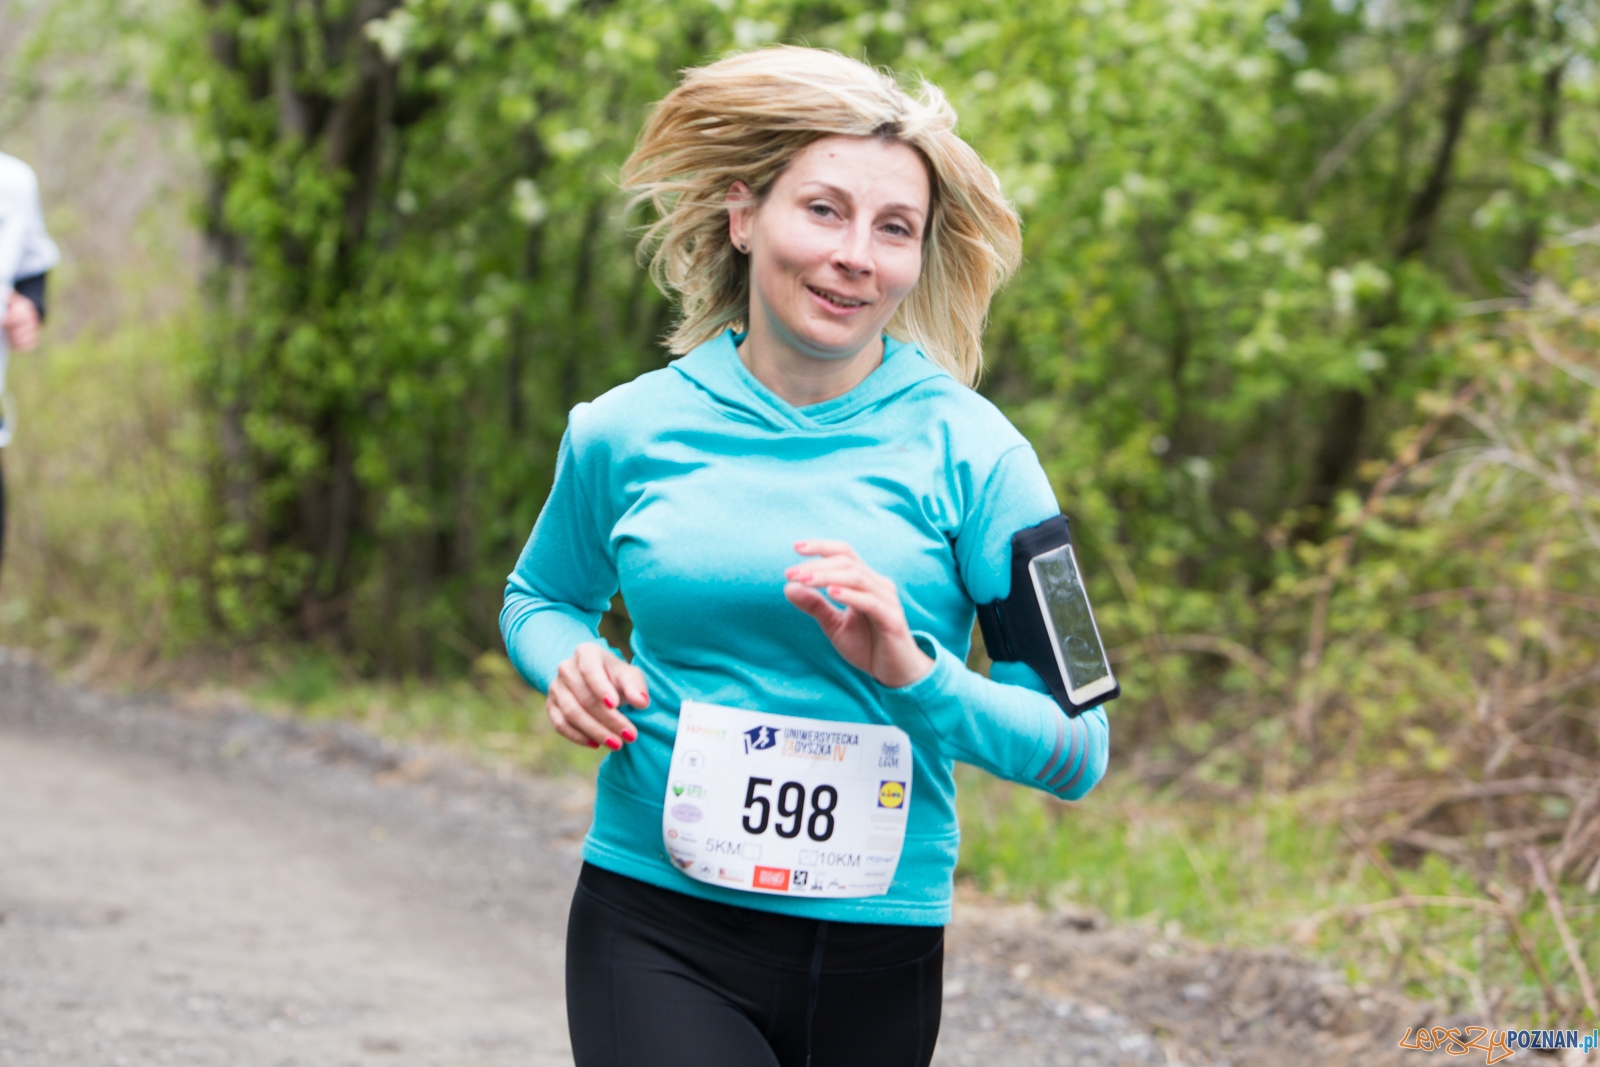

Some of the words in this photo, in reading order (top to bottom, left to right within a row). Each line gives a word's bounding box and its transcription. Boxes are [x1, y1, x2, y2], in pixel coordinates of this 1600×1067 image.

[783, 728, 859, 745] UNIWERSYTECKA
[782, 738, 831, 756] ZADYSZKA
[833, 745, 847, 762] IV
[742, 776, 838, 842] 598
[704, 838, 741, 856] 5KM
[819, 852, 861, 867] 10KM
